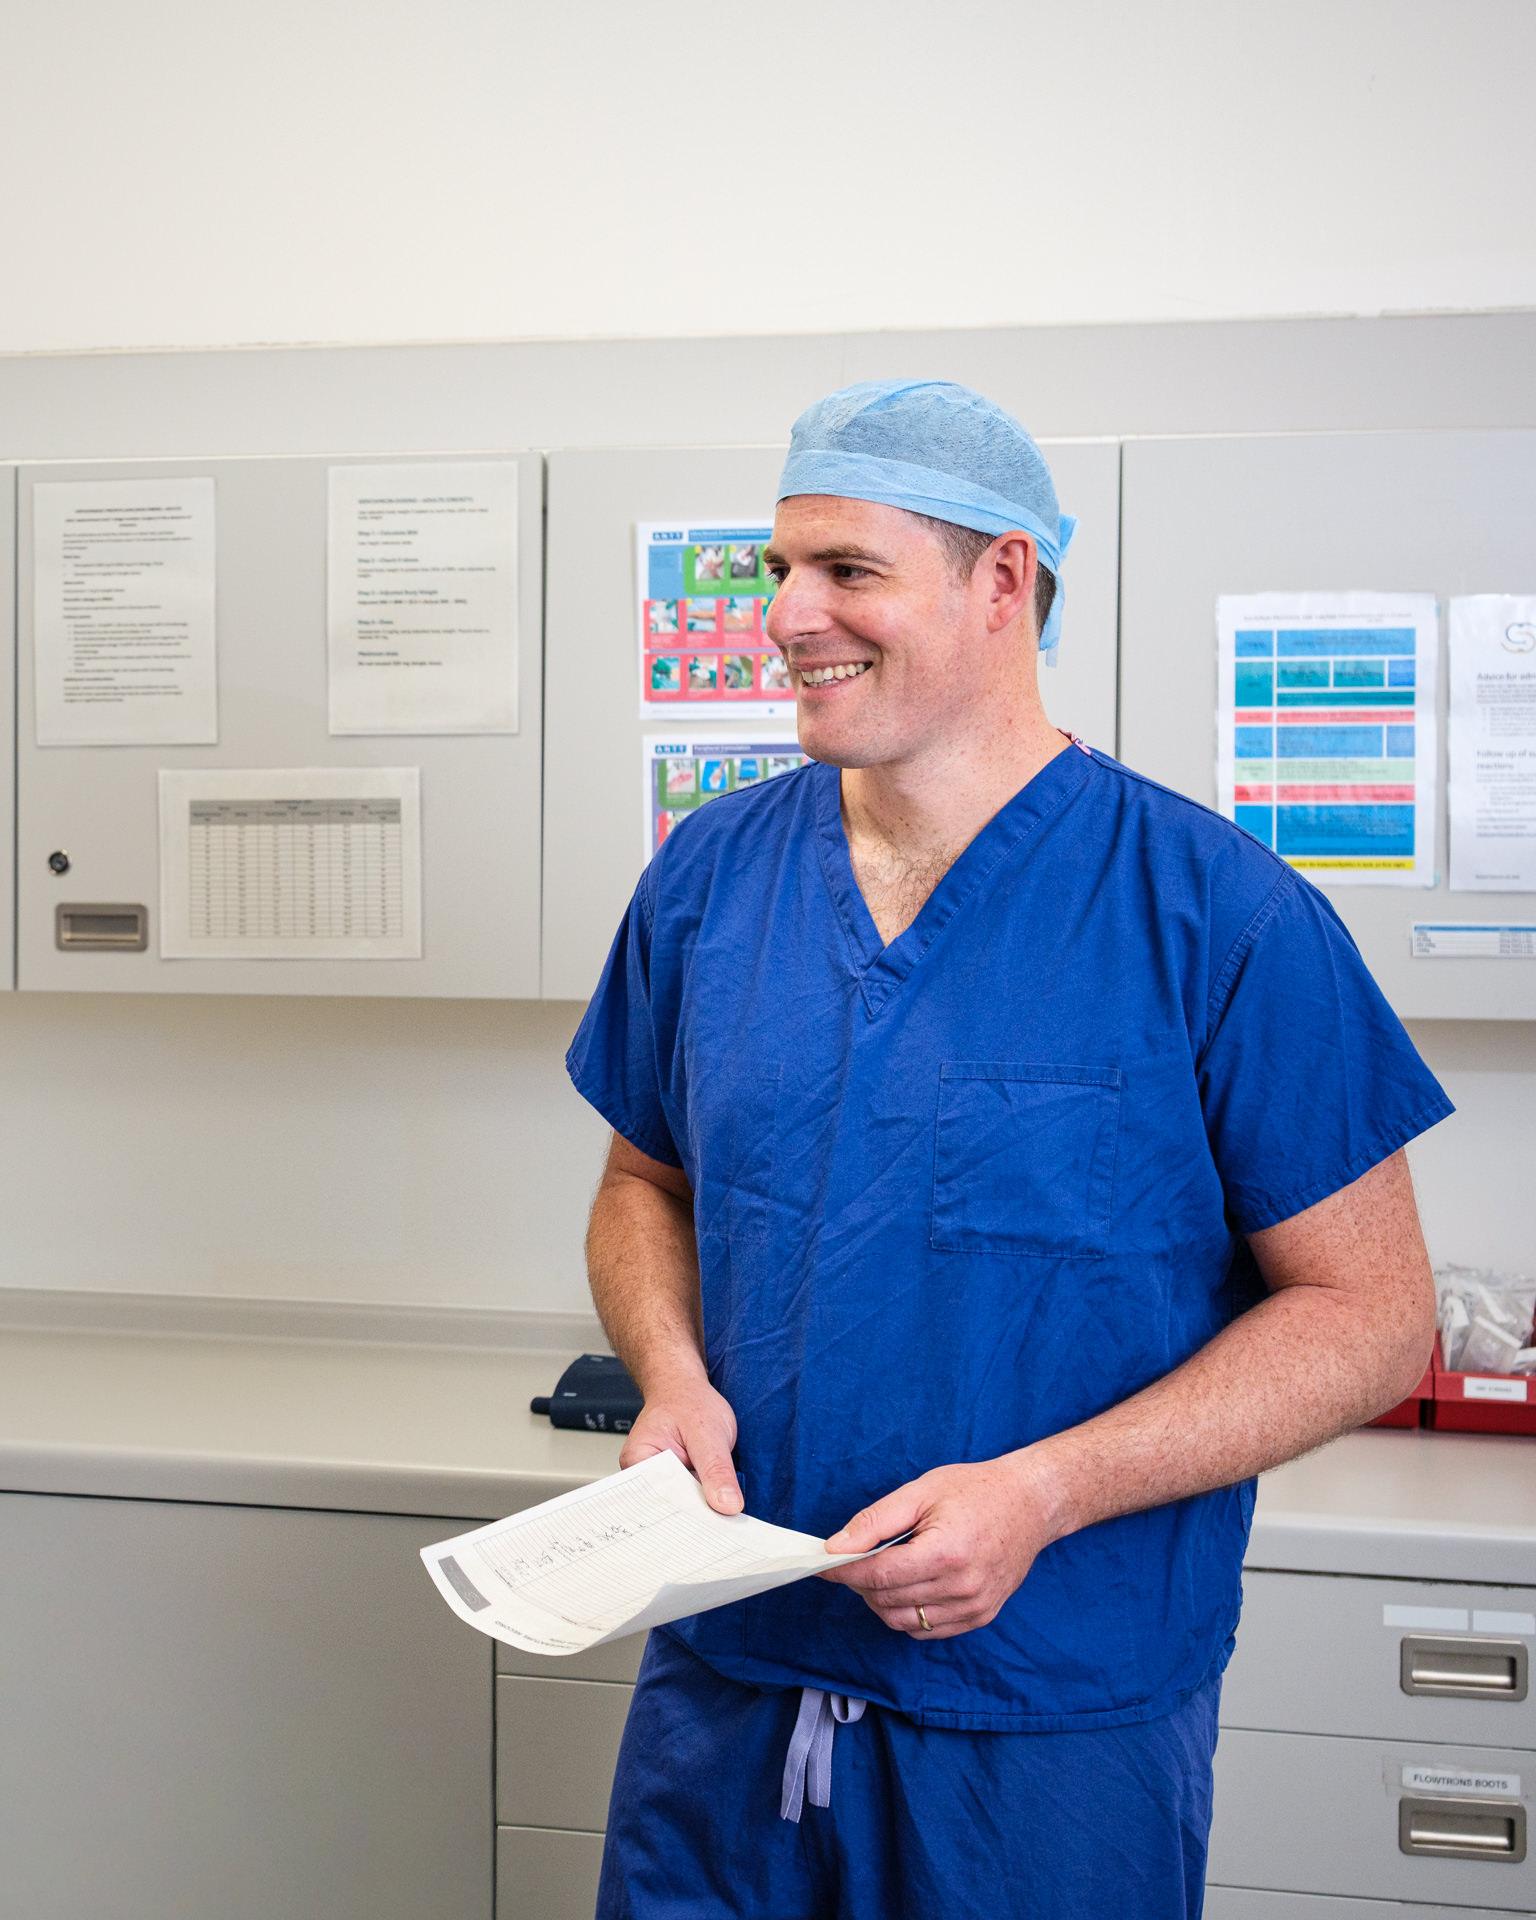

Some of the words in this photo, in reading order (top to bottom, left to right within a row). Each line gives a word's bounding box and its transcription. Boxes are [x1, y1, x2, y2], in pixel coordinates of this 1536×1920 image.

[653, 532, 683, 541] ANTT
[1476, 672, 1504, 681] Advice
[1506, 672, 1517, 681] for
[655, 745, 686, 753] ANTT
[1413, 1773, 1473, 1787] FLOWTRONS
[1474, 1778, 1508, 1790] BOOTS
